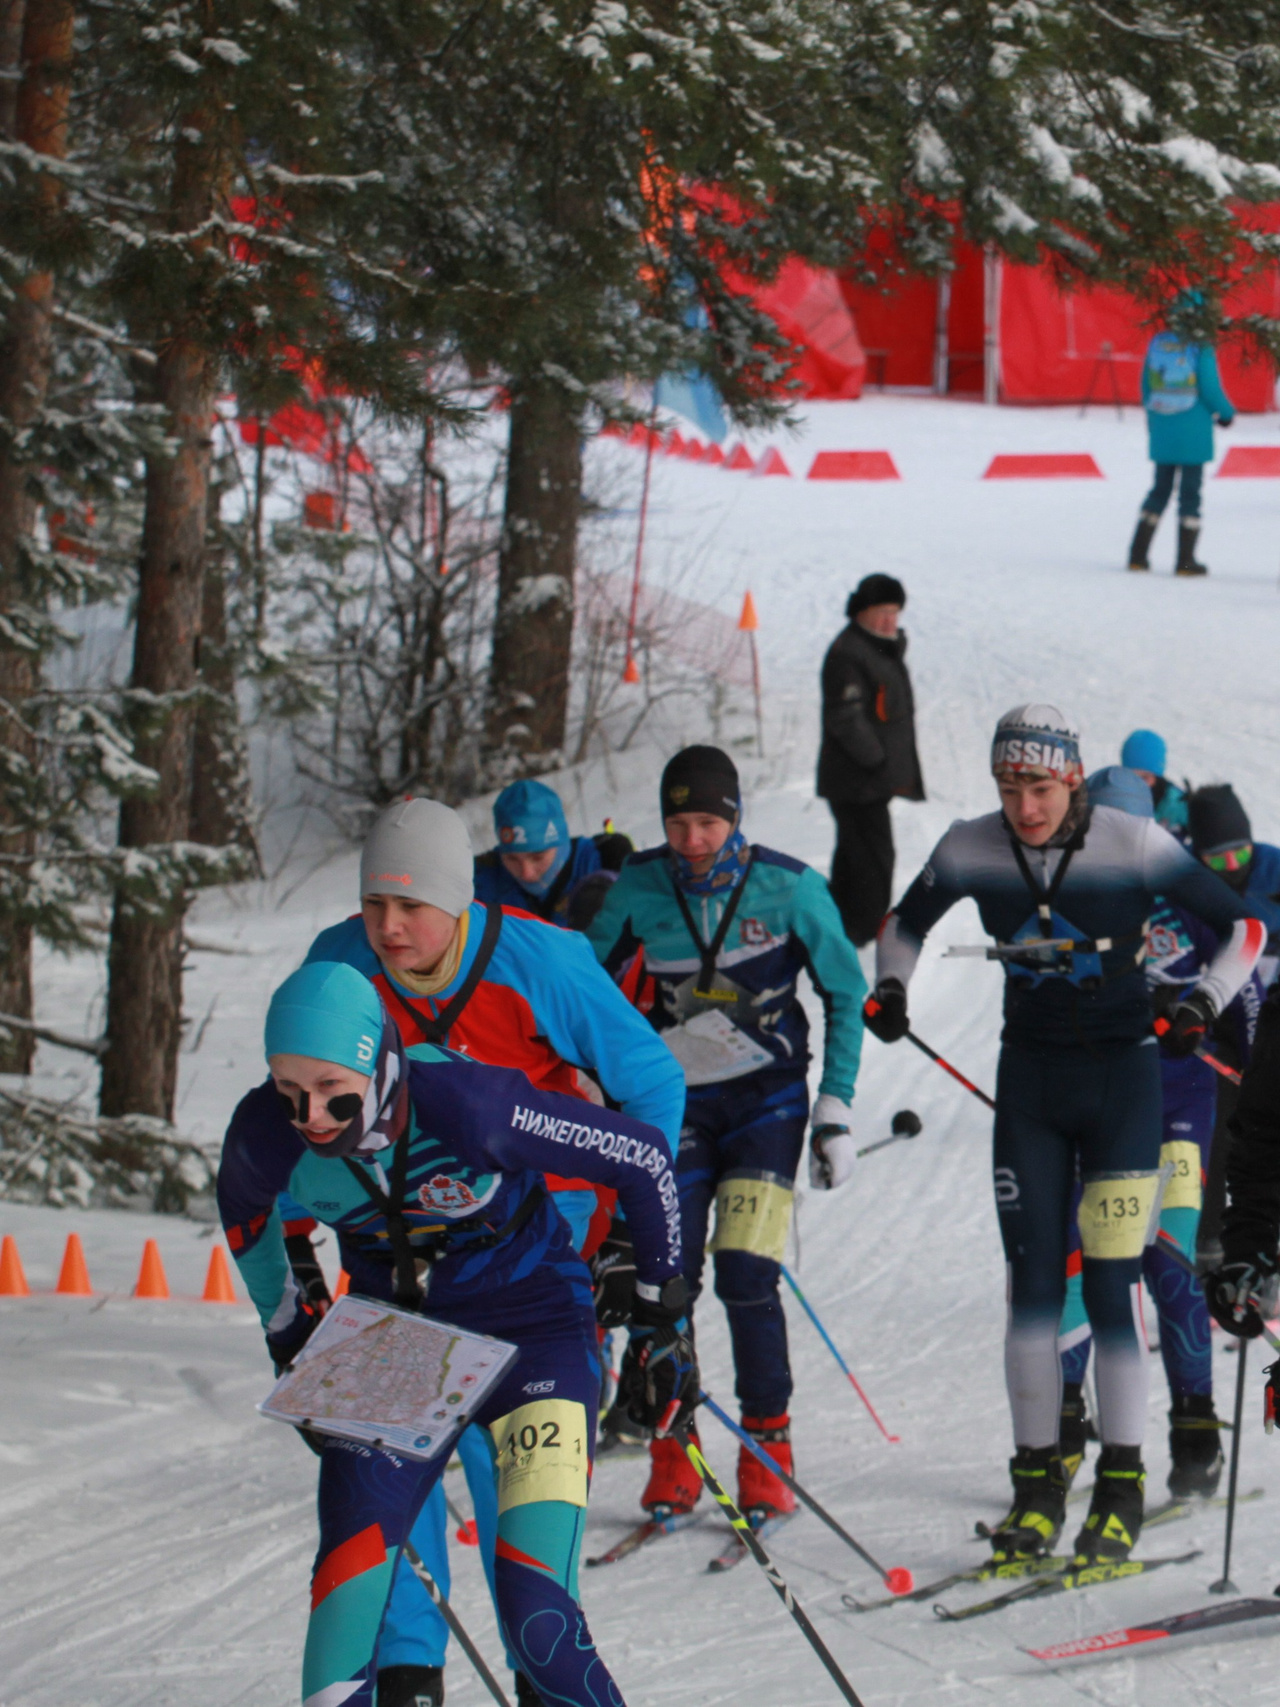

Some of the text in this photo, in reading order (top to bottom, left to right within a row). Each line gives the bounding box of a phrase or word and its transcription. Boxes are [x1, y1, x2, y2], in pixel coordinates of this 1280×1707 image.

[511, 1105, 668, 1179] НИЖЕГОРОДСКАЯ
[1098, 1197, 1140, 1219] 133
[508, 1422, 561, 1457] 102
